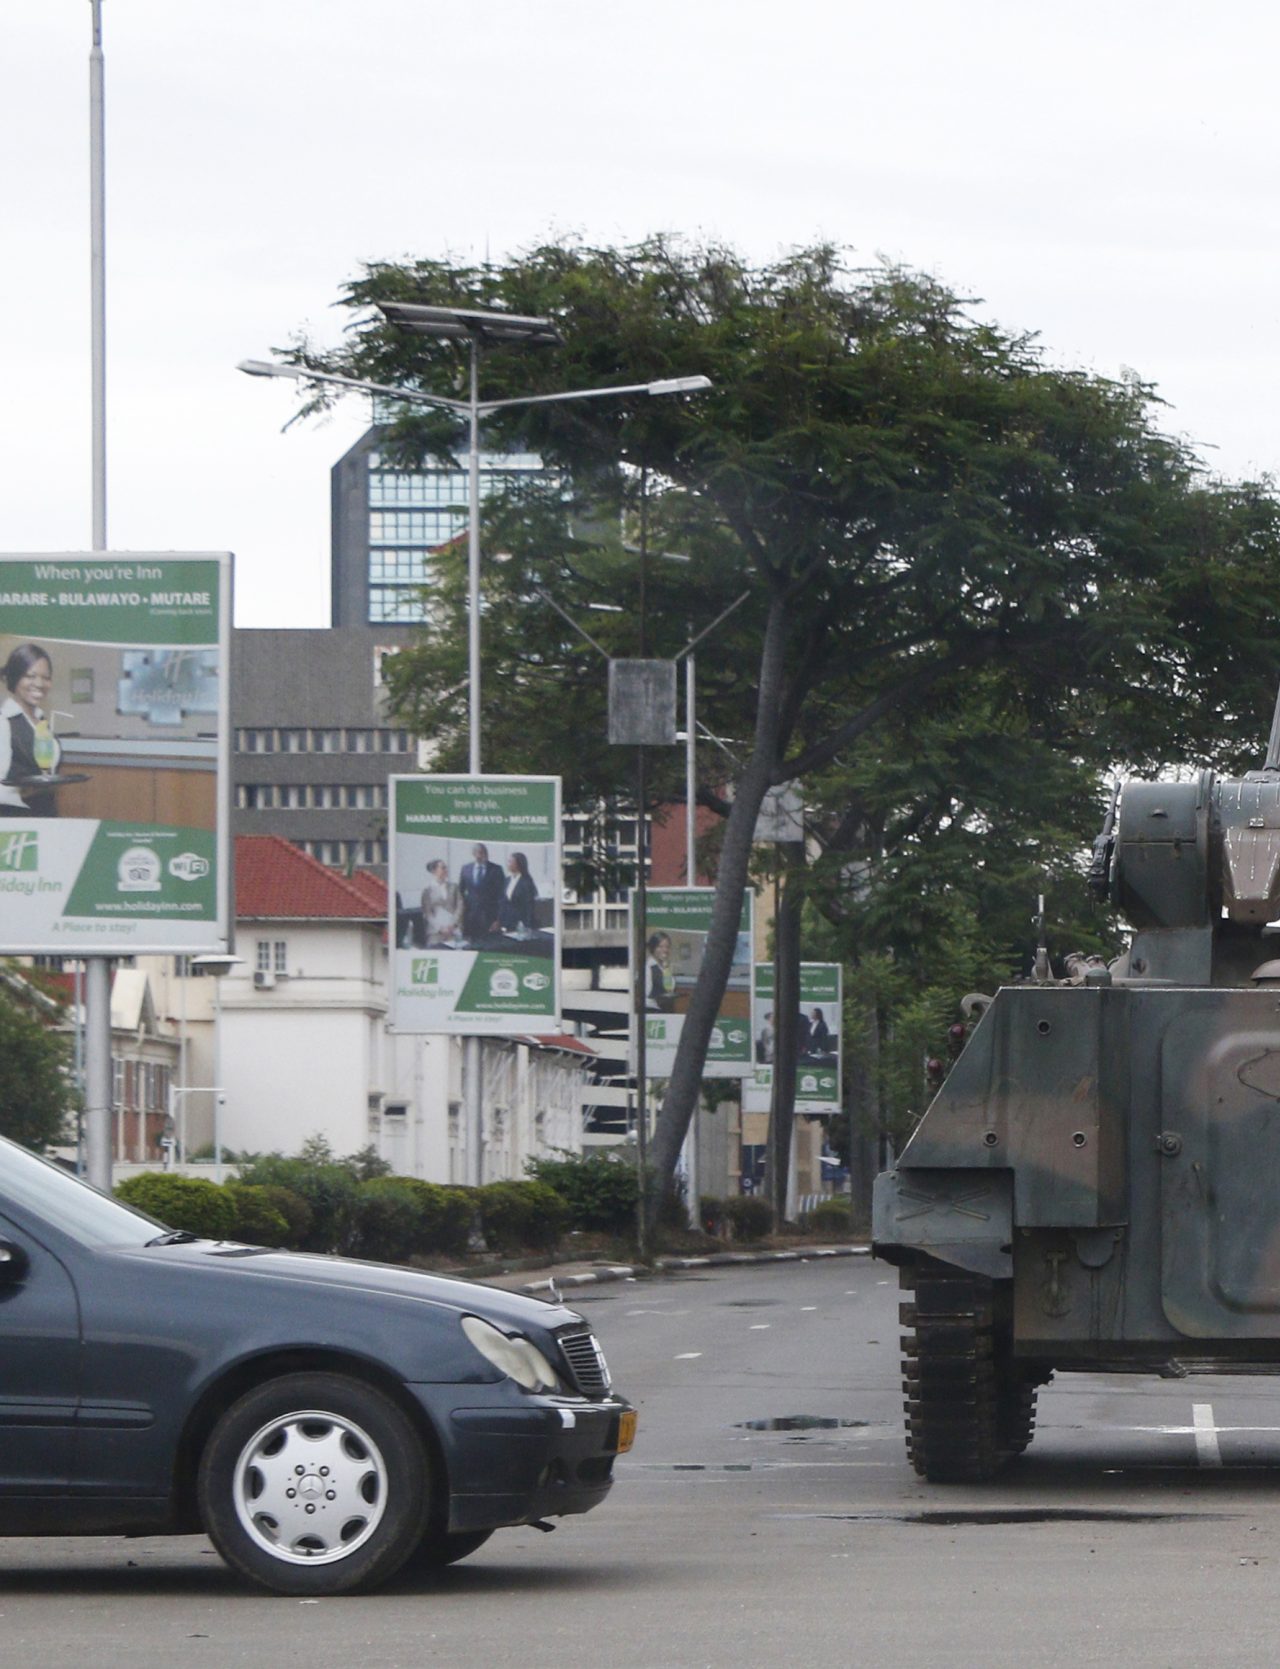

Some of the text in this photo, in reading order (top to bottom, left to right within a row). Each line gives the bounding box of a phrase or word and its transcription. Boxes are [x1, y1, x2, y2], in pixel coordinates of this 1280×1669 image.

[34, 565, 162, 584] When you're Inn
[59, 592, 141, 606] BULAWAYO
[150, 592, 211, 606] MUTARE
[424, 784, 528, 796] You can do business
[454, 799, 500, 811] Inn style.
[405, 814, 549, 825] HARARE BULAWAYO MUTARE
[38, 876, 62, 892] Inn
[95, 902, 203, 913] www.holidayinn.com
